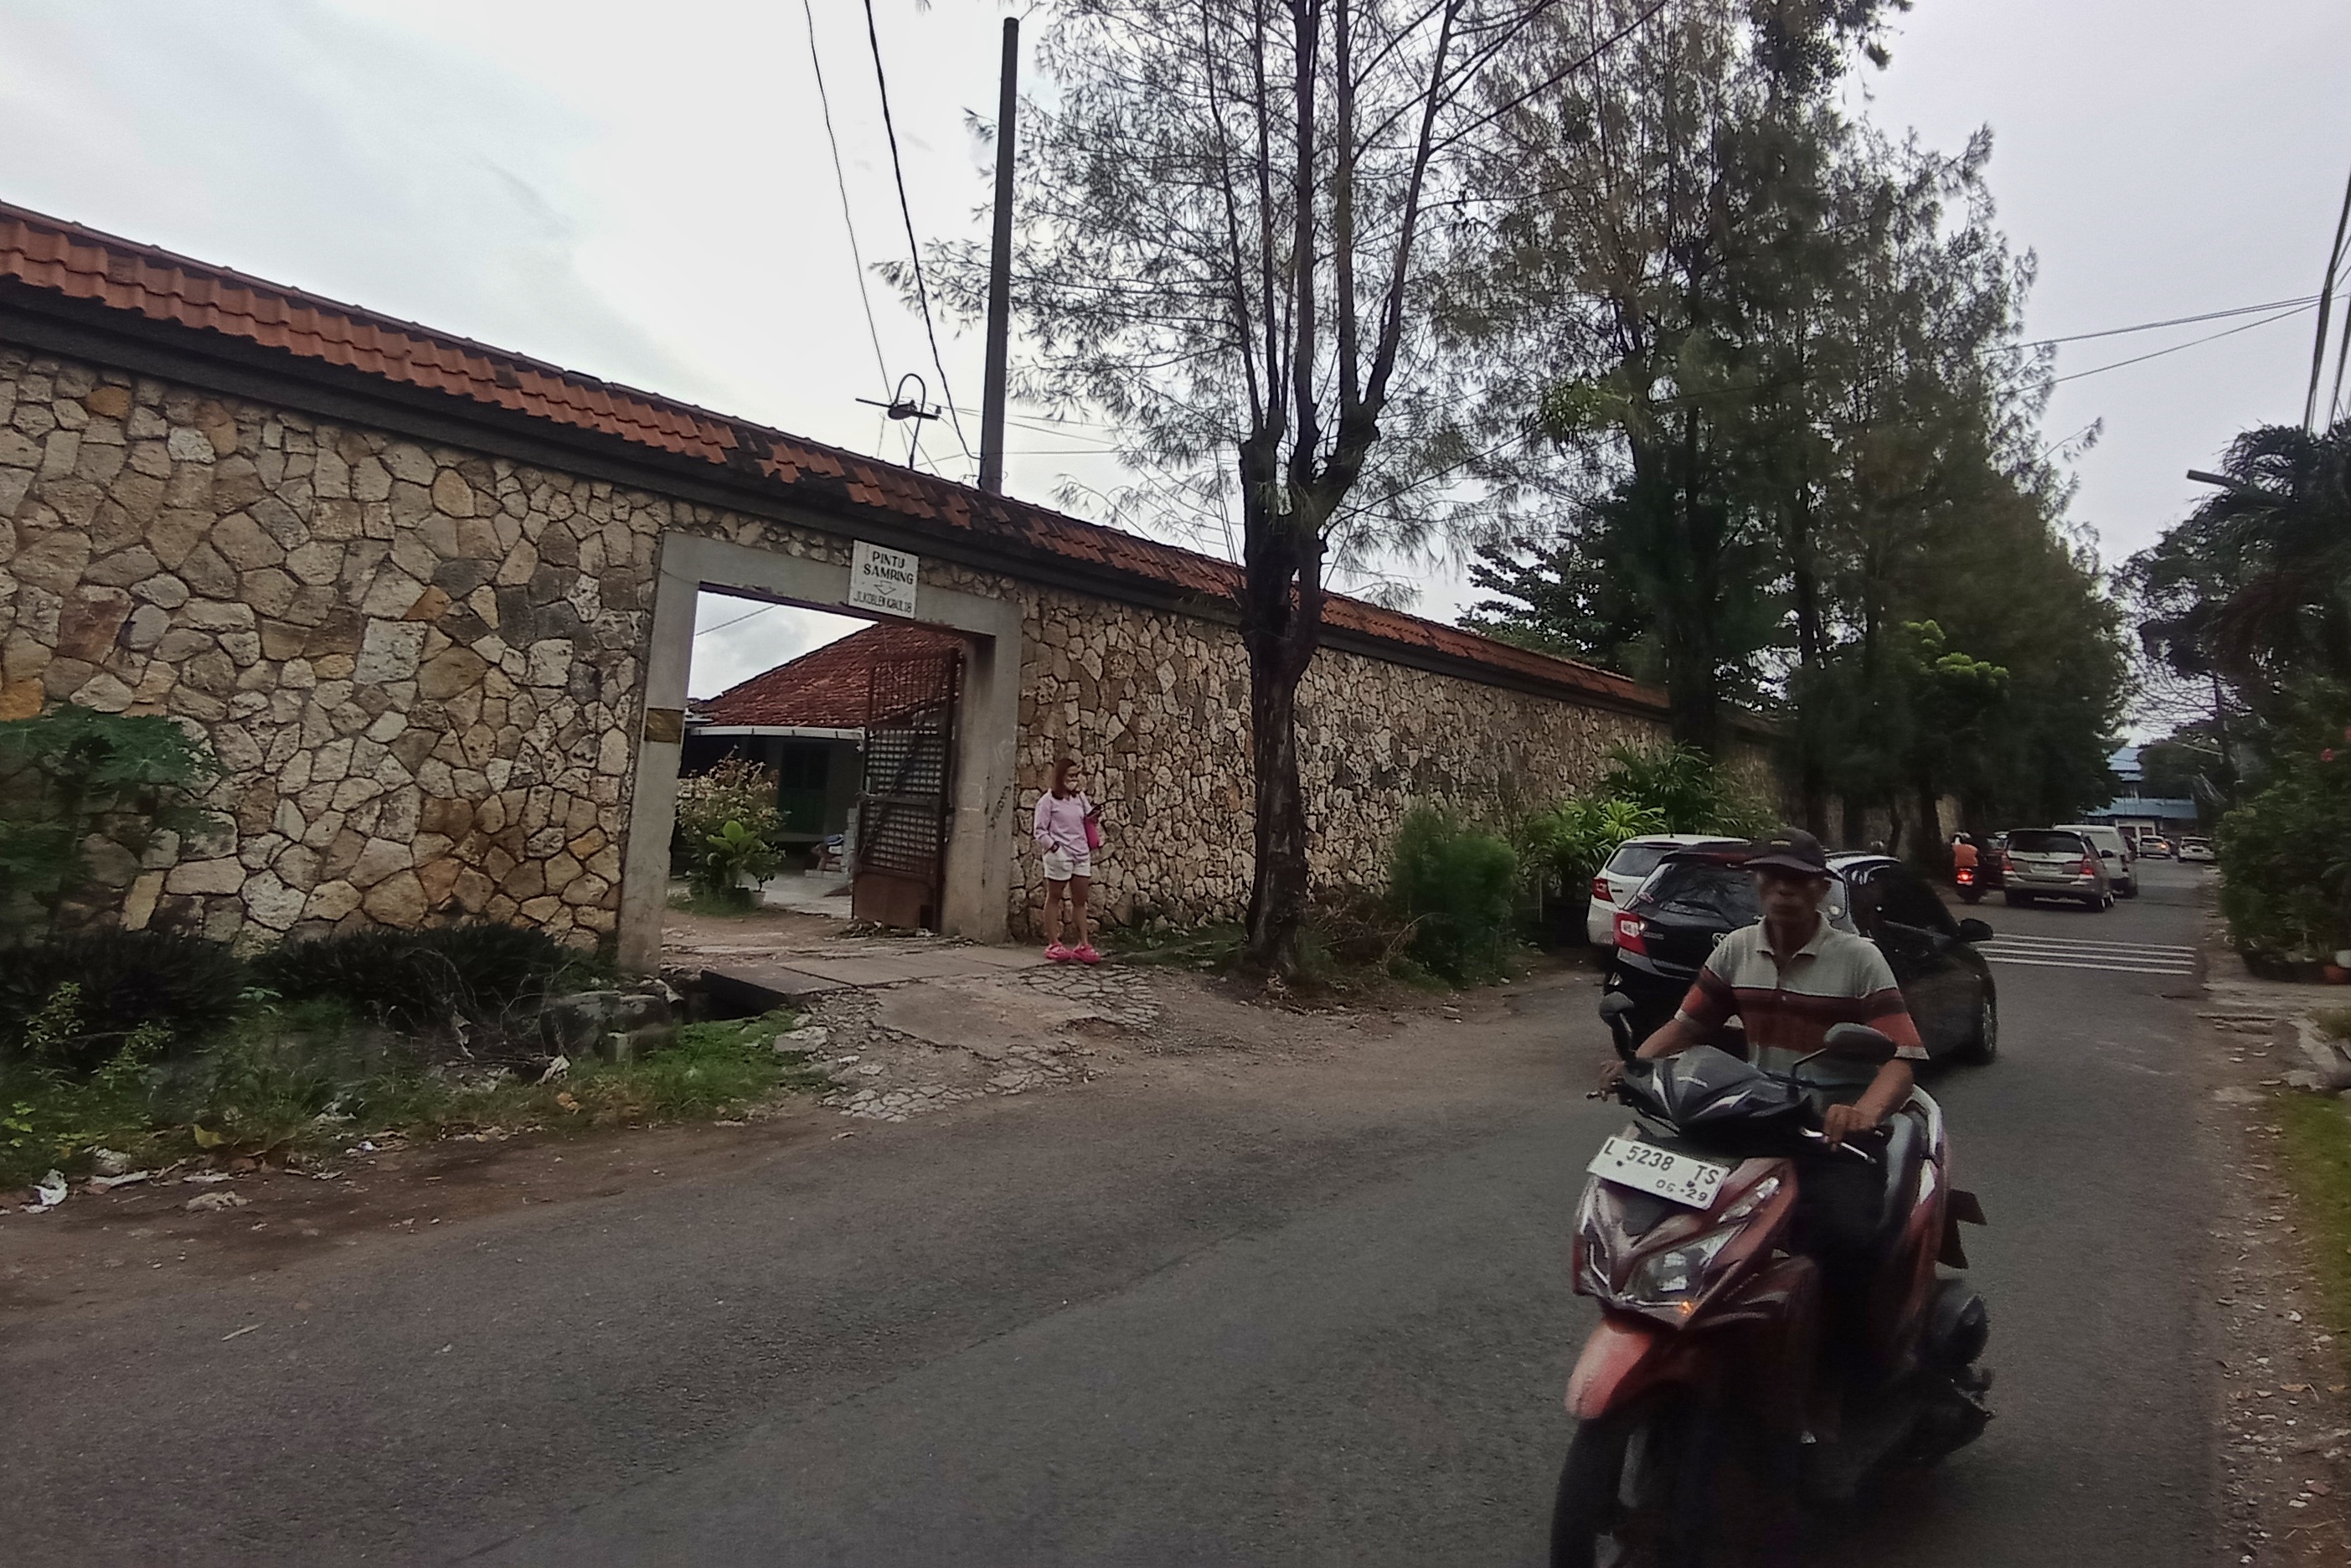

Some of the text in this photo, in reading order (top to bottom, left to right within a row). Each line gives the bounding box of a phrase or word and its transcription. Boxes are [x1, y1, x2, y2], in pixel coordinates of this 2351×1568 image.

[873, 550, 905, 569] PINTU
[1604, 1140, 1719, 1185] L 5238 TS
